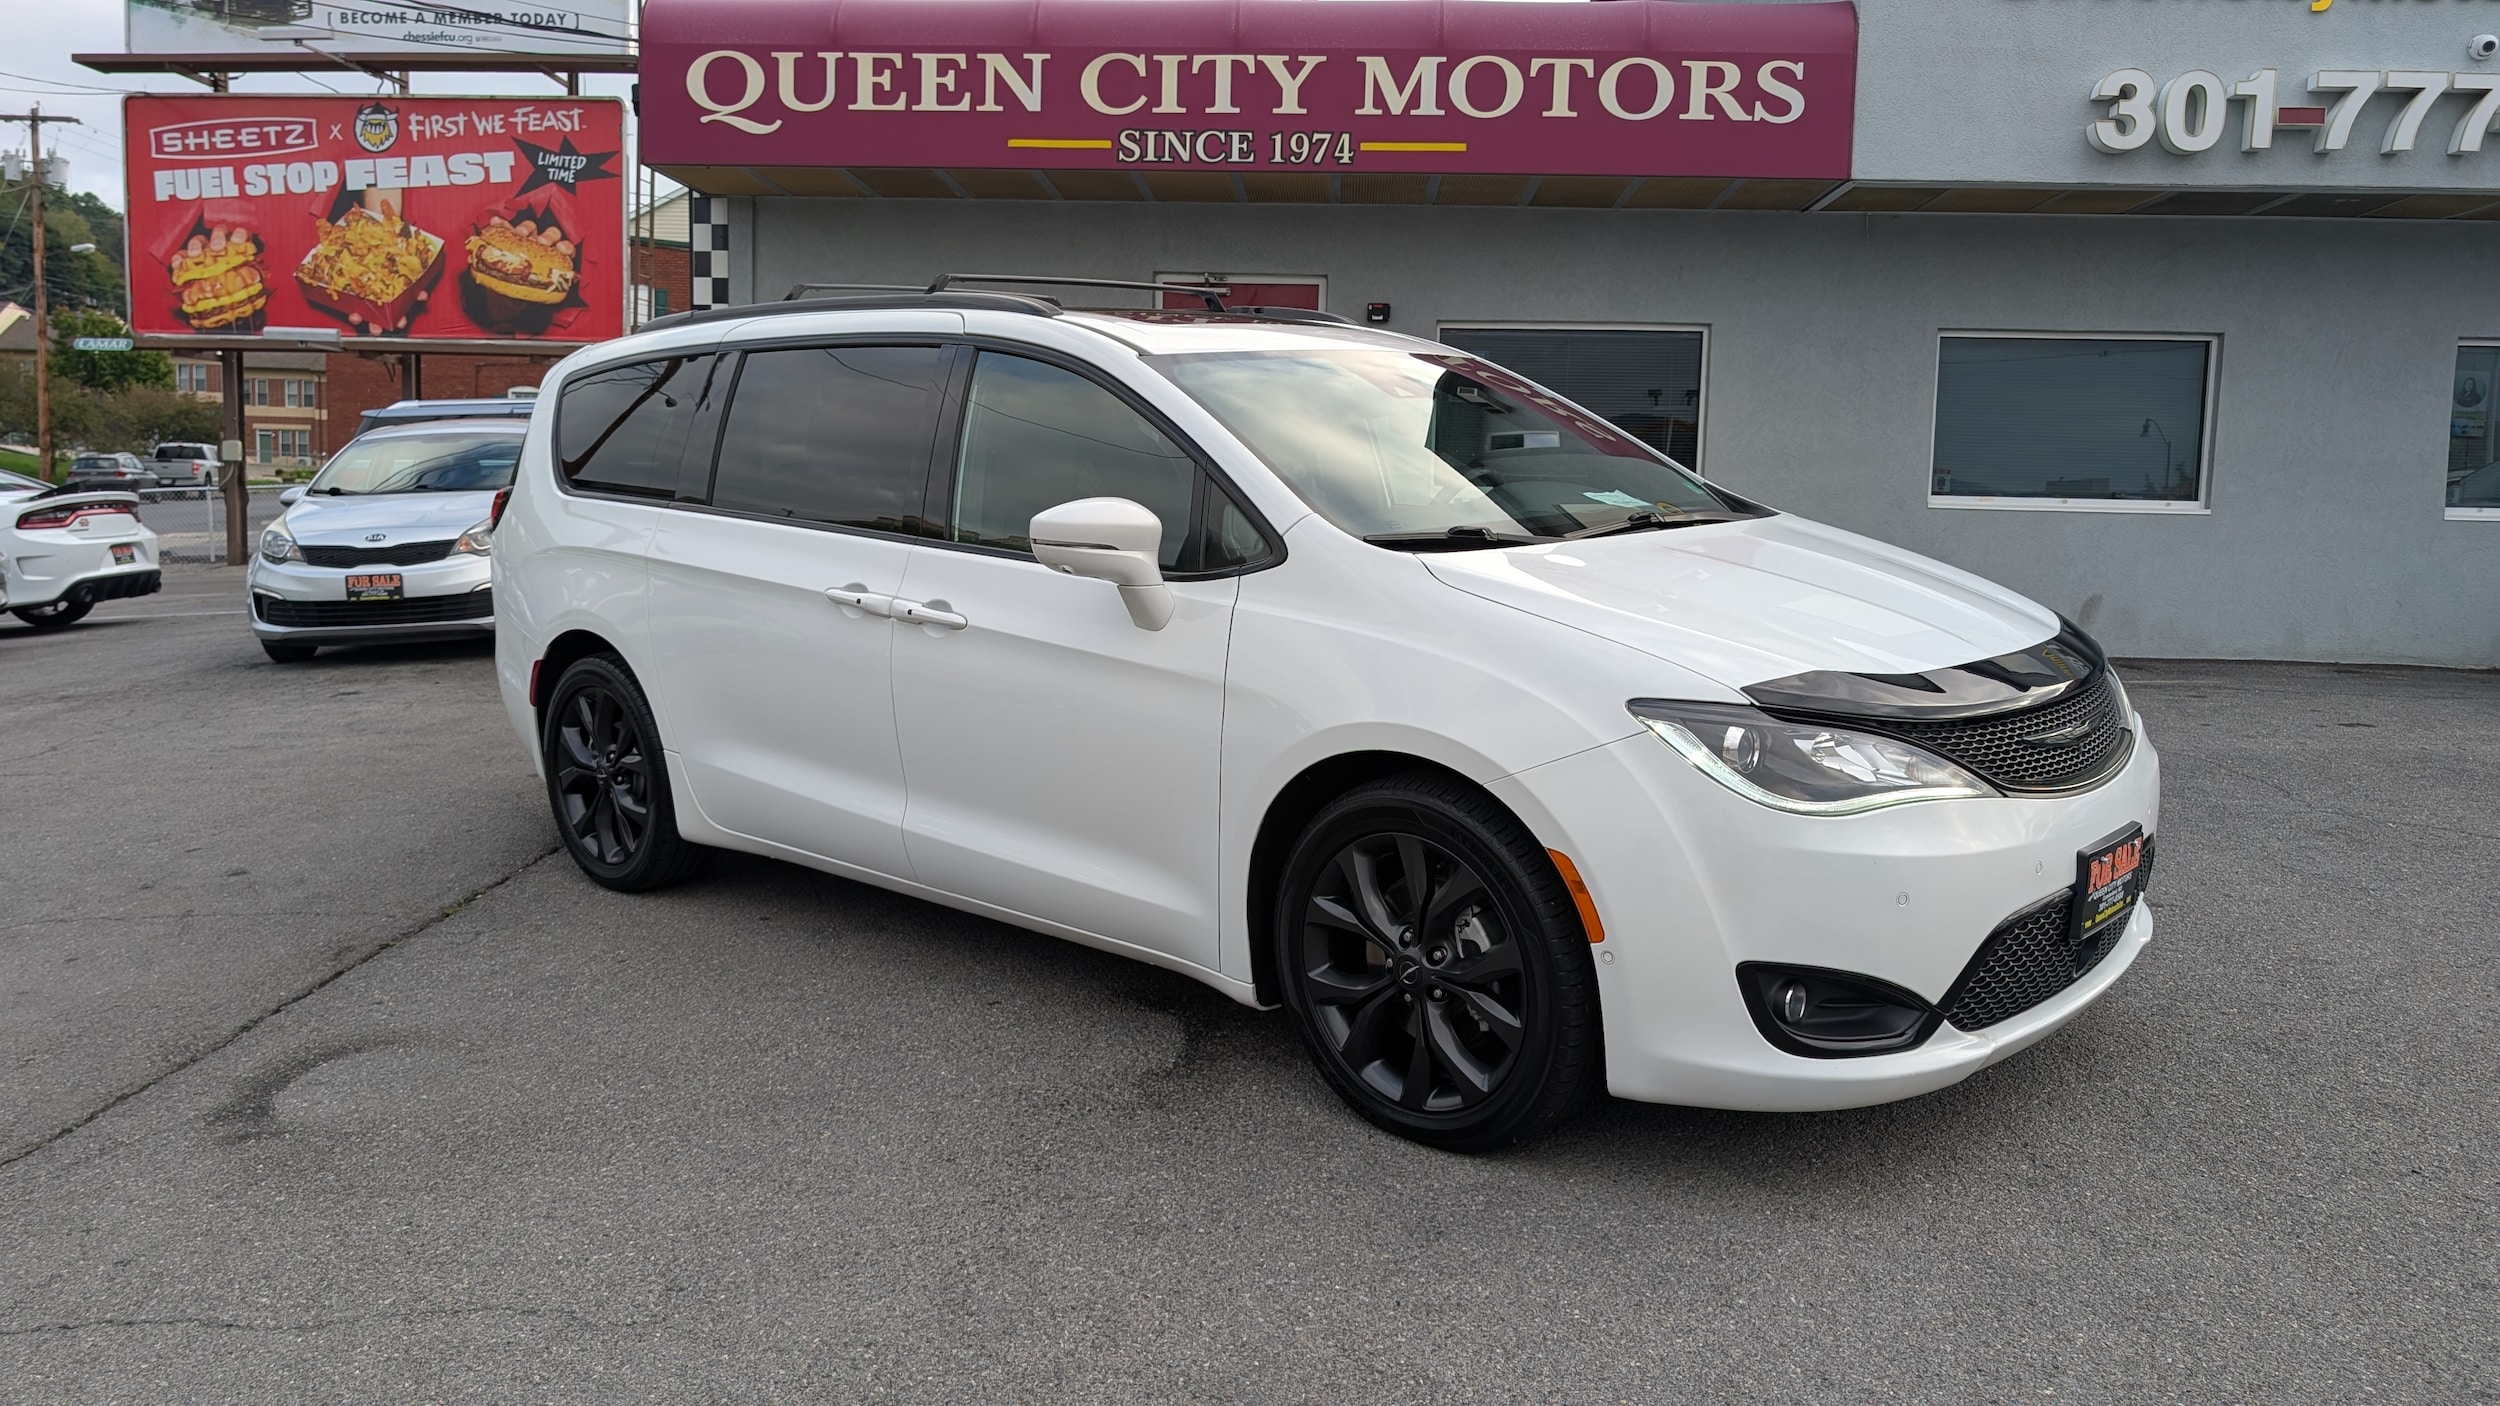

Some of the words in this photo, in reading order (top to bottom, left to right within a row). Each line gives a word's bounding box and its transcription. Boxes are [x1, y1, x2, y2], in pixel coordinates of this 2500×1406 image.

[340, 12, 407, 24] BECOME
[414, 13, 426, 24] A
[434, 12, 503, 25] MEMBER
[510, 13, 568, 26] TODAY
[403, 31, 473, 45] chessiefcu.org
[686, 50, 1052, 135] QUEEN
[1080, 52, 1327, 116] CITY
[1354, 55, 1806, 124] MOTORS
[162, 125, 305, 152] SHEETZ
[408, 112, 468, 142] FIRST
[471, 111, 506, 136] WE
[508, 106, 584, 135] FEAST
[1117, 129, 1255, 163] SINCE
[1269, 131, 1355, 165] 1974
[537, 152, 587, 170] LIMITED
[153, 166, 240, 201] FUEL
[243, 161, 339, 196] STOP
[345, 151, 516, 191] FEAST
[547, 168, 576, 183] TIME
[79, 338, 127, 349] LAMAR
[347, 575, 371, 588] FOR
[372, 574, 401, 587] SALE
[2113, 836, 2143, 880] SALE
